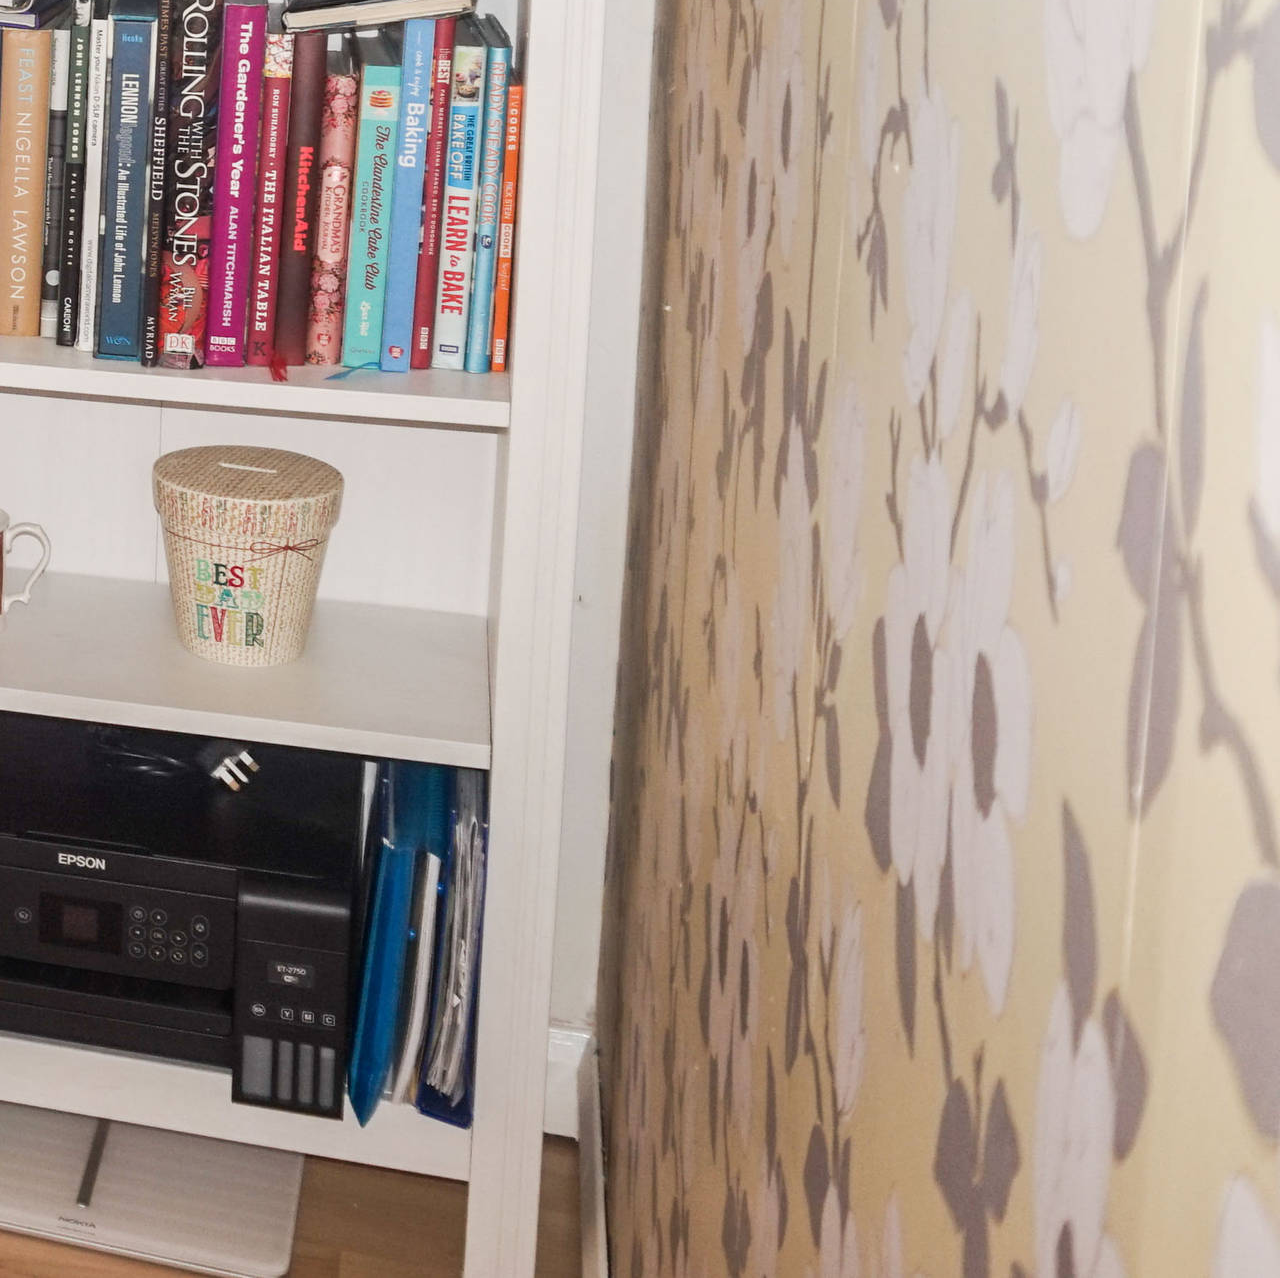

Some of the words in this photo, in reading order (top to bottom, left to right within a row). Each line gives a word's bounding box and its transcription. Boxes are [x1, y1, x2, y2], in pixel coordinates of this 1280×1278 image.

[75, 38, 84, 67] JOHN
[238, 21, 254, 55] The
[17, 47, 36, 103] FEAST
[488, 60, 507, 114] READY
[73, 73, 82, 116] LENNON
[120, 73, 140, 123] LENNON
[232, 59, 251, 155] Gardener's
[272, 88, 281, 104] RON
[71, 122, 80, 159] SONGS
[177, 126, 191, 153] THE
[190, 121, 205, 159] WITH
[375, 124, 390, 151] The
[398, 102, 425, 168] Baking
[452, 114, 466, 149] BAKE
[483, 118, 503, 177] STEADY
[13, 112, 33, 198] NIGELLA
[151, 116, 167, 201] SHEFFIELD
[449, 151, 464, 181] OFF
[229, 159, 244, 198] Year
[264, 169, 277, 203] THE
[369, 153, 388, 225] Clandestine
[115, 182, 130, 224] Illustrated
[172, 159, 208, 267] STONES
[293, 146, 315, 252] KitchenAid
[479, 183, 499, 226] COOK
[115, 225, 128, 241] Life
[227, 206, 239, 240] ALAN
[258, 208, 275, 276] ITALIAN
[445, 194, 471, 252] LEARN
[501, 223, 512, 258] COOKS
[9, 210, 30, 299] LAWSON
[113, 253, 127, 273] John
[114, 242, 125, 252] of
[366, 227, 383, 261] Cake
[450, 254, 460, 268] to
[112, 275, 126, 303] Lennon
[222, 243, 237, 327] TITCHMARSH
[364, 262, 380, 291] Club
[441, 270, 465, 315] BAKE
[255, 279, 273, 332] TABLE
[145, 316, 156, 359] MYRIAD
[168, 334, 191, 348] DK
[252, 341, 267, 356] K
[195, 558, 265, 590] BEST
[195, 583, 265, 611] DAD
[196, 603, 265, 648] EVER
[58, 853, 106, 871] EPSON
